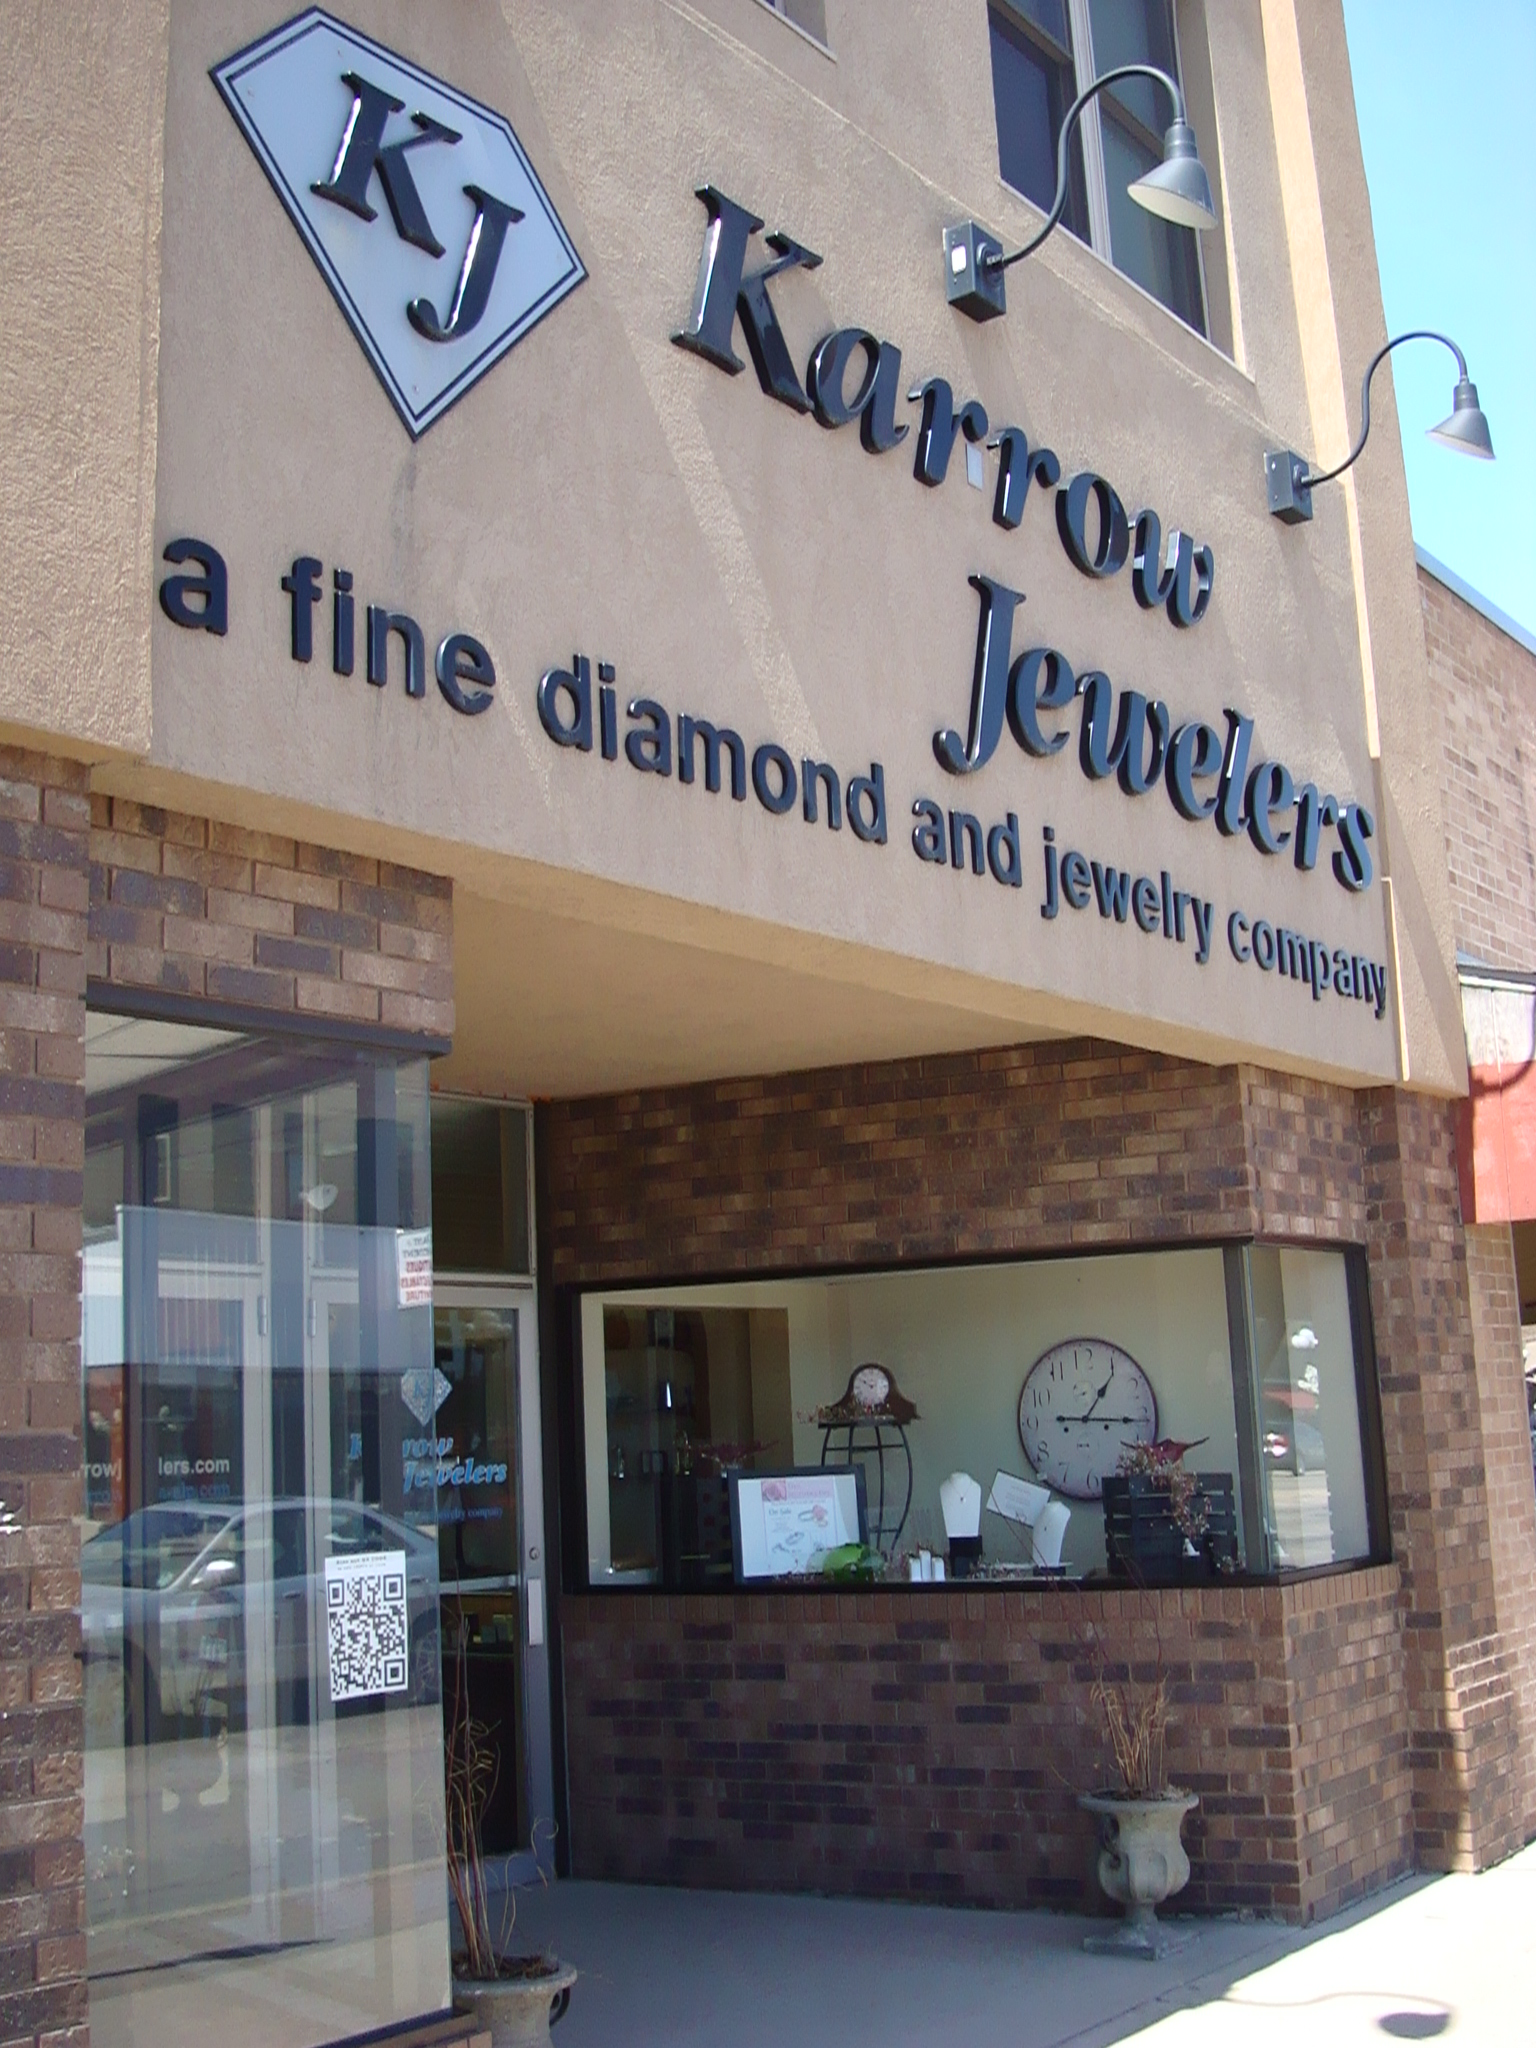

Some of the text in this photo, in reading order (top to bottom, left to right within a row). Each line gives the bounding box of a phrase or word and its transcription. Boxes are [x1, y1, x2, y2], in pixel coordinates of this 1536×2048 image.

[310, 70, 525, 343] KJ
[671, 184, 1214, 628] Karrow
[159, 538, 1387, 1020] a fine diamond and jewelry company
[933, 574, 1374, 892] Jewelers
